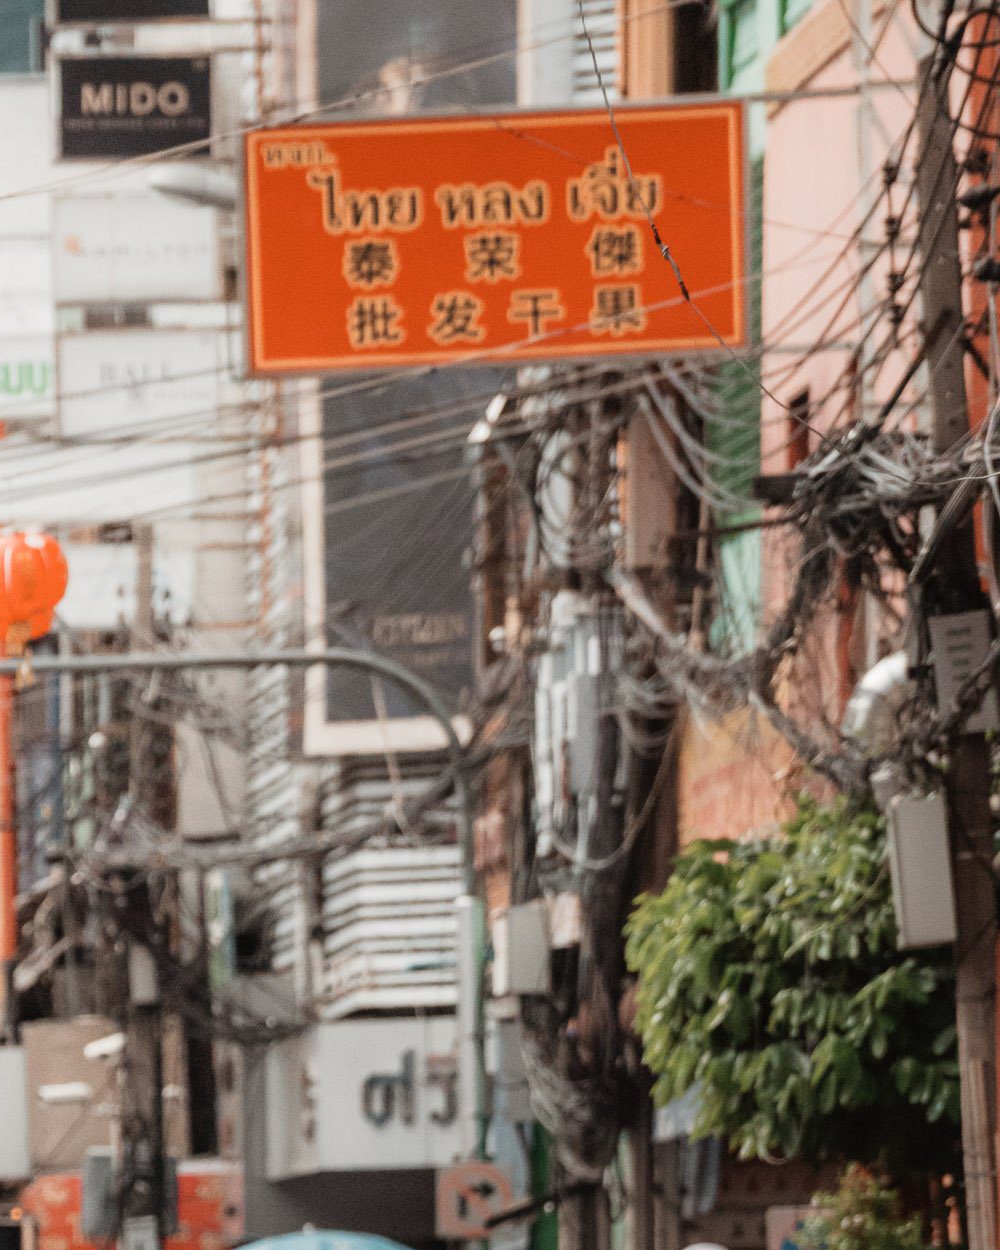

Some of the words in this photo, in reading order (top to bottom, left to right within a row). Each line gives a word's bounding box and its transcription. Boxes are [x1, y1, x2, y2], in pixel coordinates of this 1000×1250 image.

[80, 81, 190, 117] MIDO
[309, 172, 421, 230] ไทย
[350, 287, 643, 344] 批发干果
